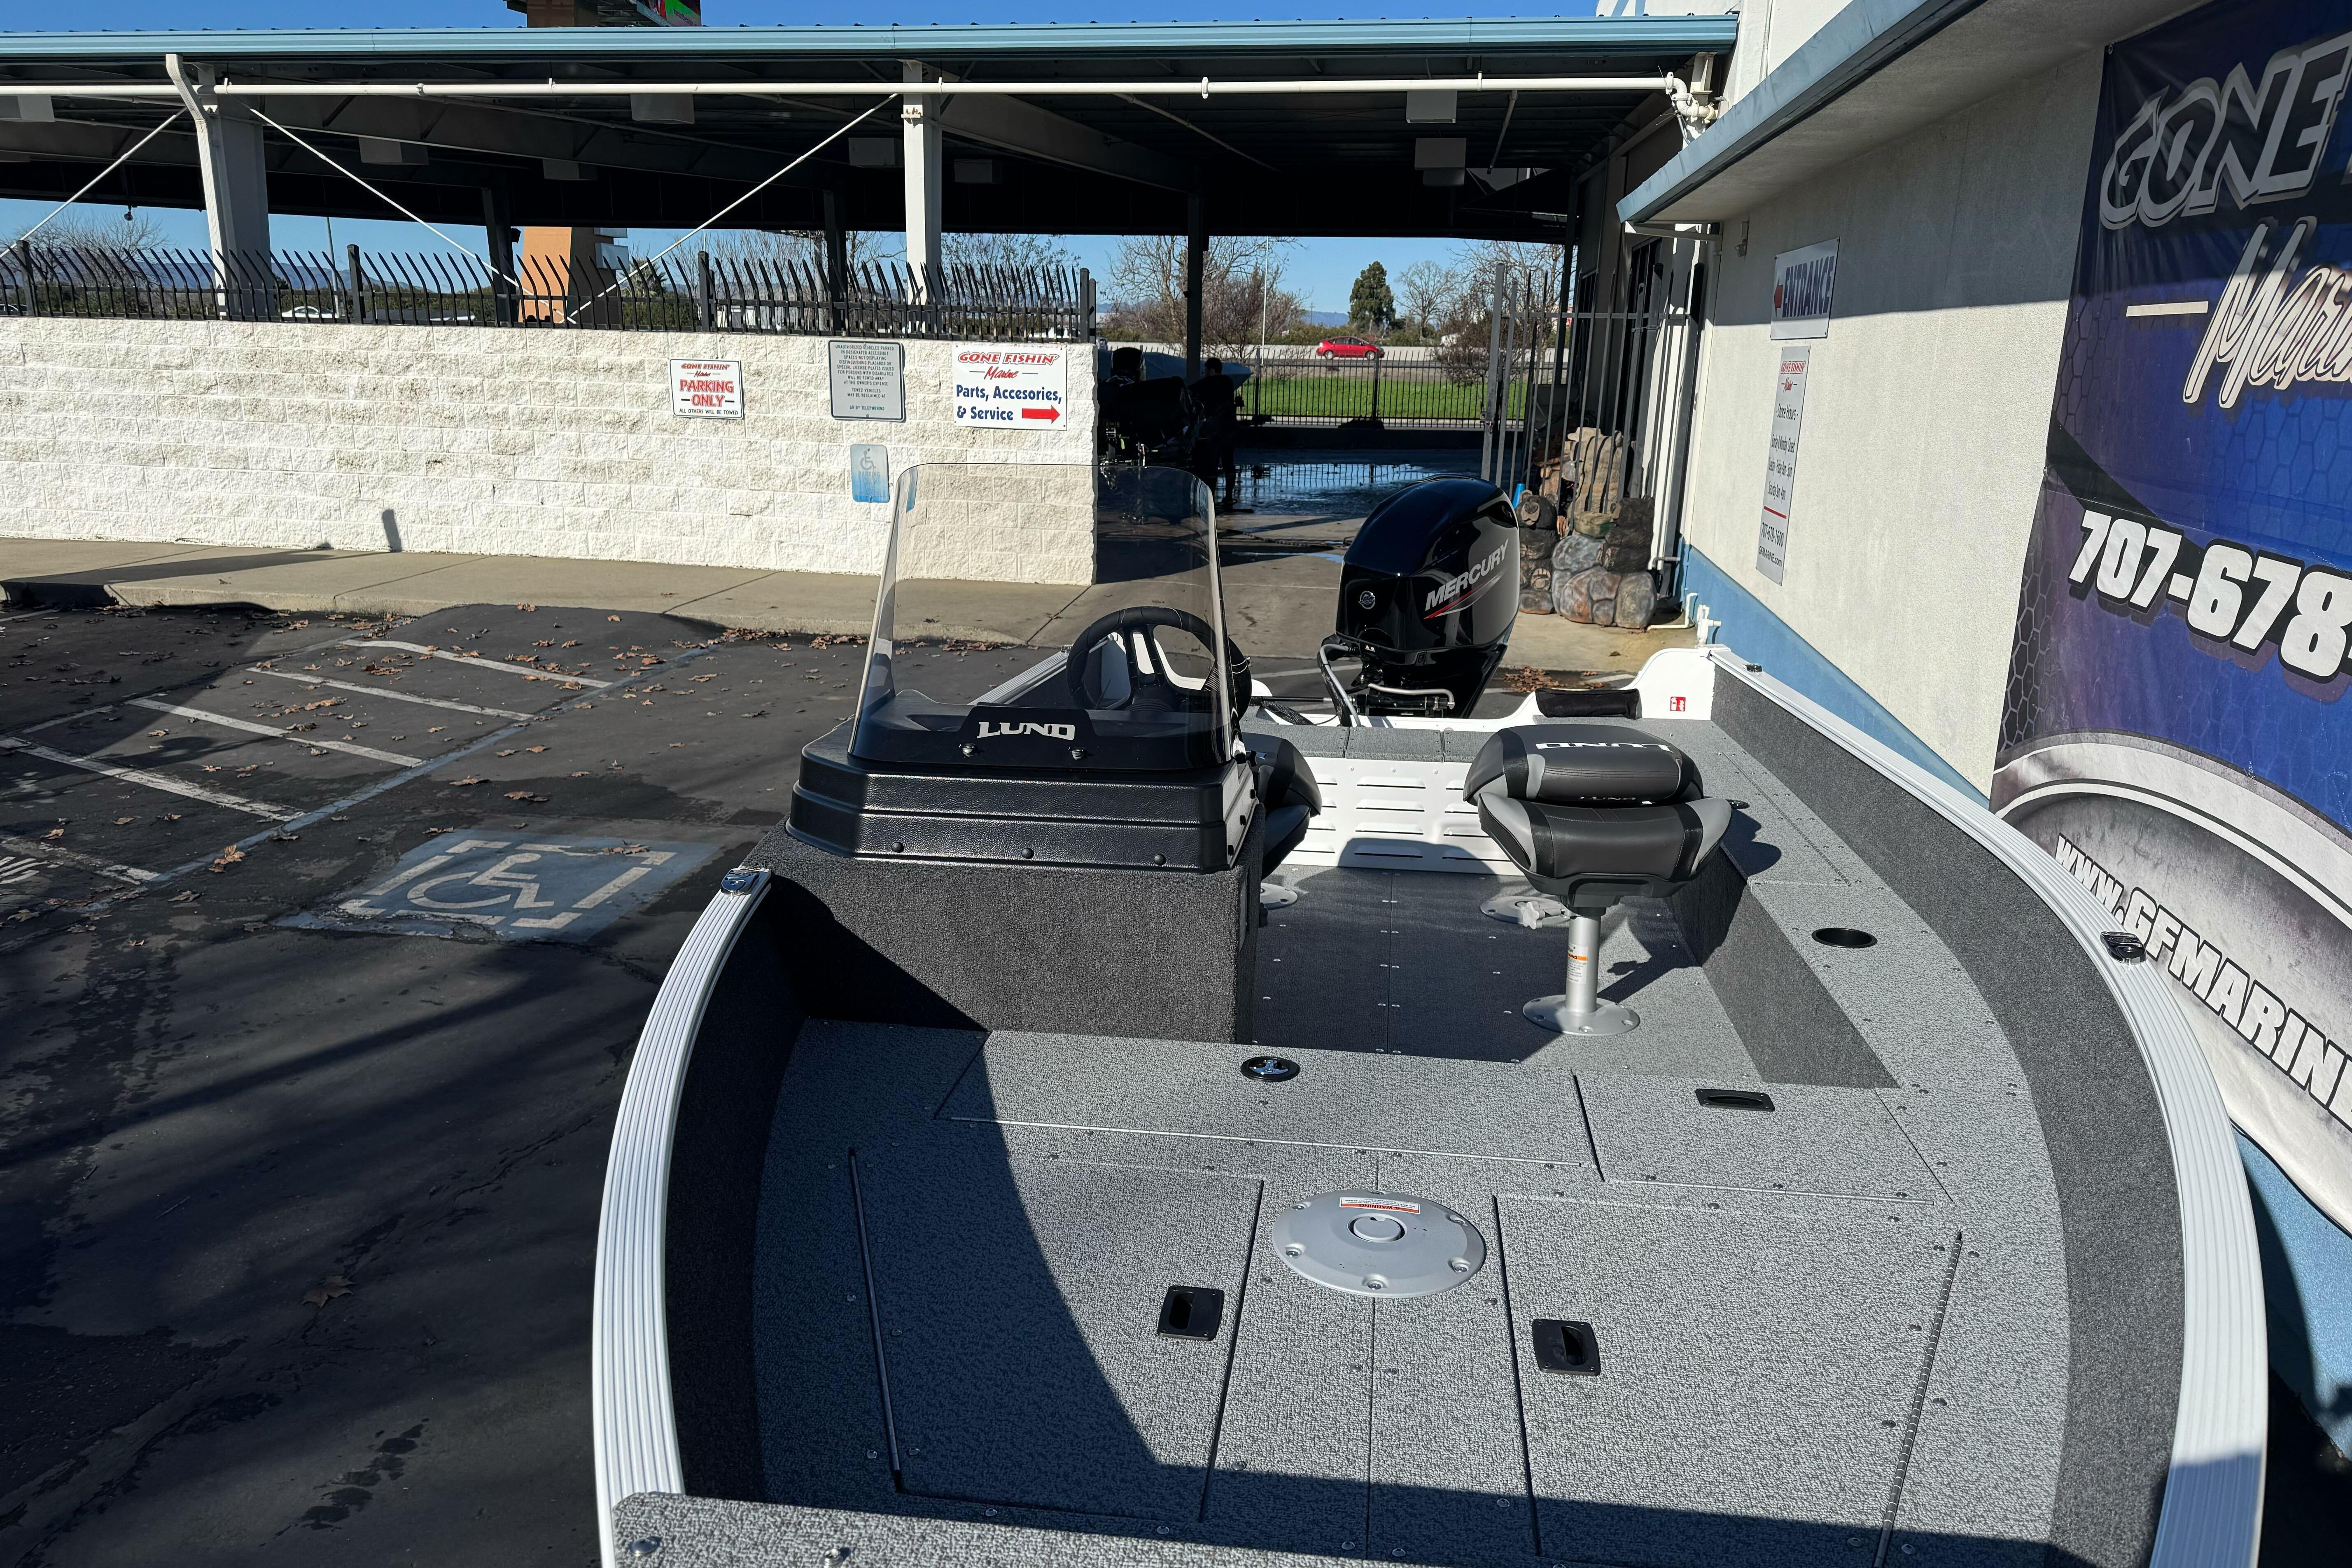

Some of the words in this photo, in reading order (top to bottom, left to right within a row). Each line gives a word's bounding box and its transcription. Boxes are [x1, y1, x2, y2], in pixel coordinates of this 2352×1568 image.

[2100, 32, 2352, 229] GONE
[1782, 255, 1835, 318] ENTRANCE
[958, 351, 1001, 364] GONE
[1003, 353, 1060, 365] FISHIN'
[984, 366, 1019, 380] Marine
[679, 379, 734, 393] PARKING
[691, 394, 725, 407] ONLY
[957, 385, 989, 401] Parts,
[993, 386, 1062, 404] Accesories,
[957, 406, 966, 418] &
[971, 406, 1013, 420] Service
[1777, 403, 1786, 419] Store
[1785, 404, 1797, 420] Hours
[1425, 539, 1509, 611] MERCURY
[977, 722, 1076, 741] LUND
[1535, 742, 1674, 753] LUND
